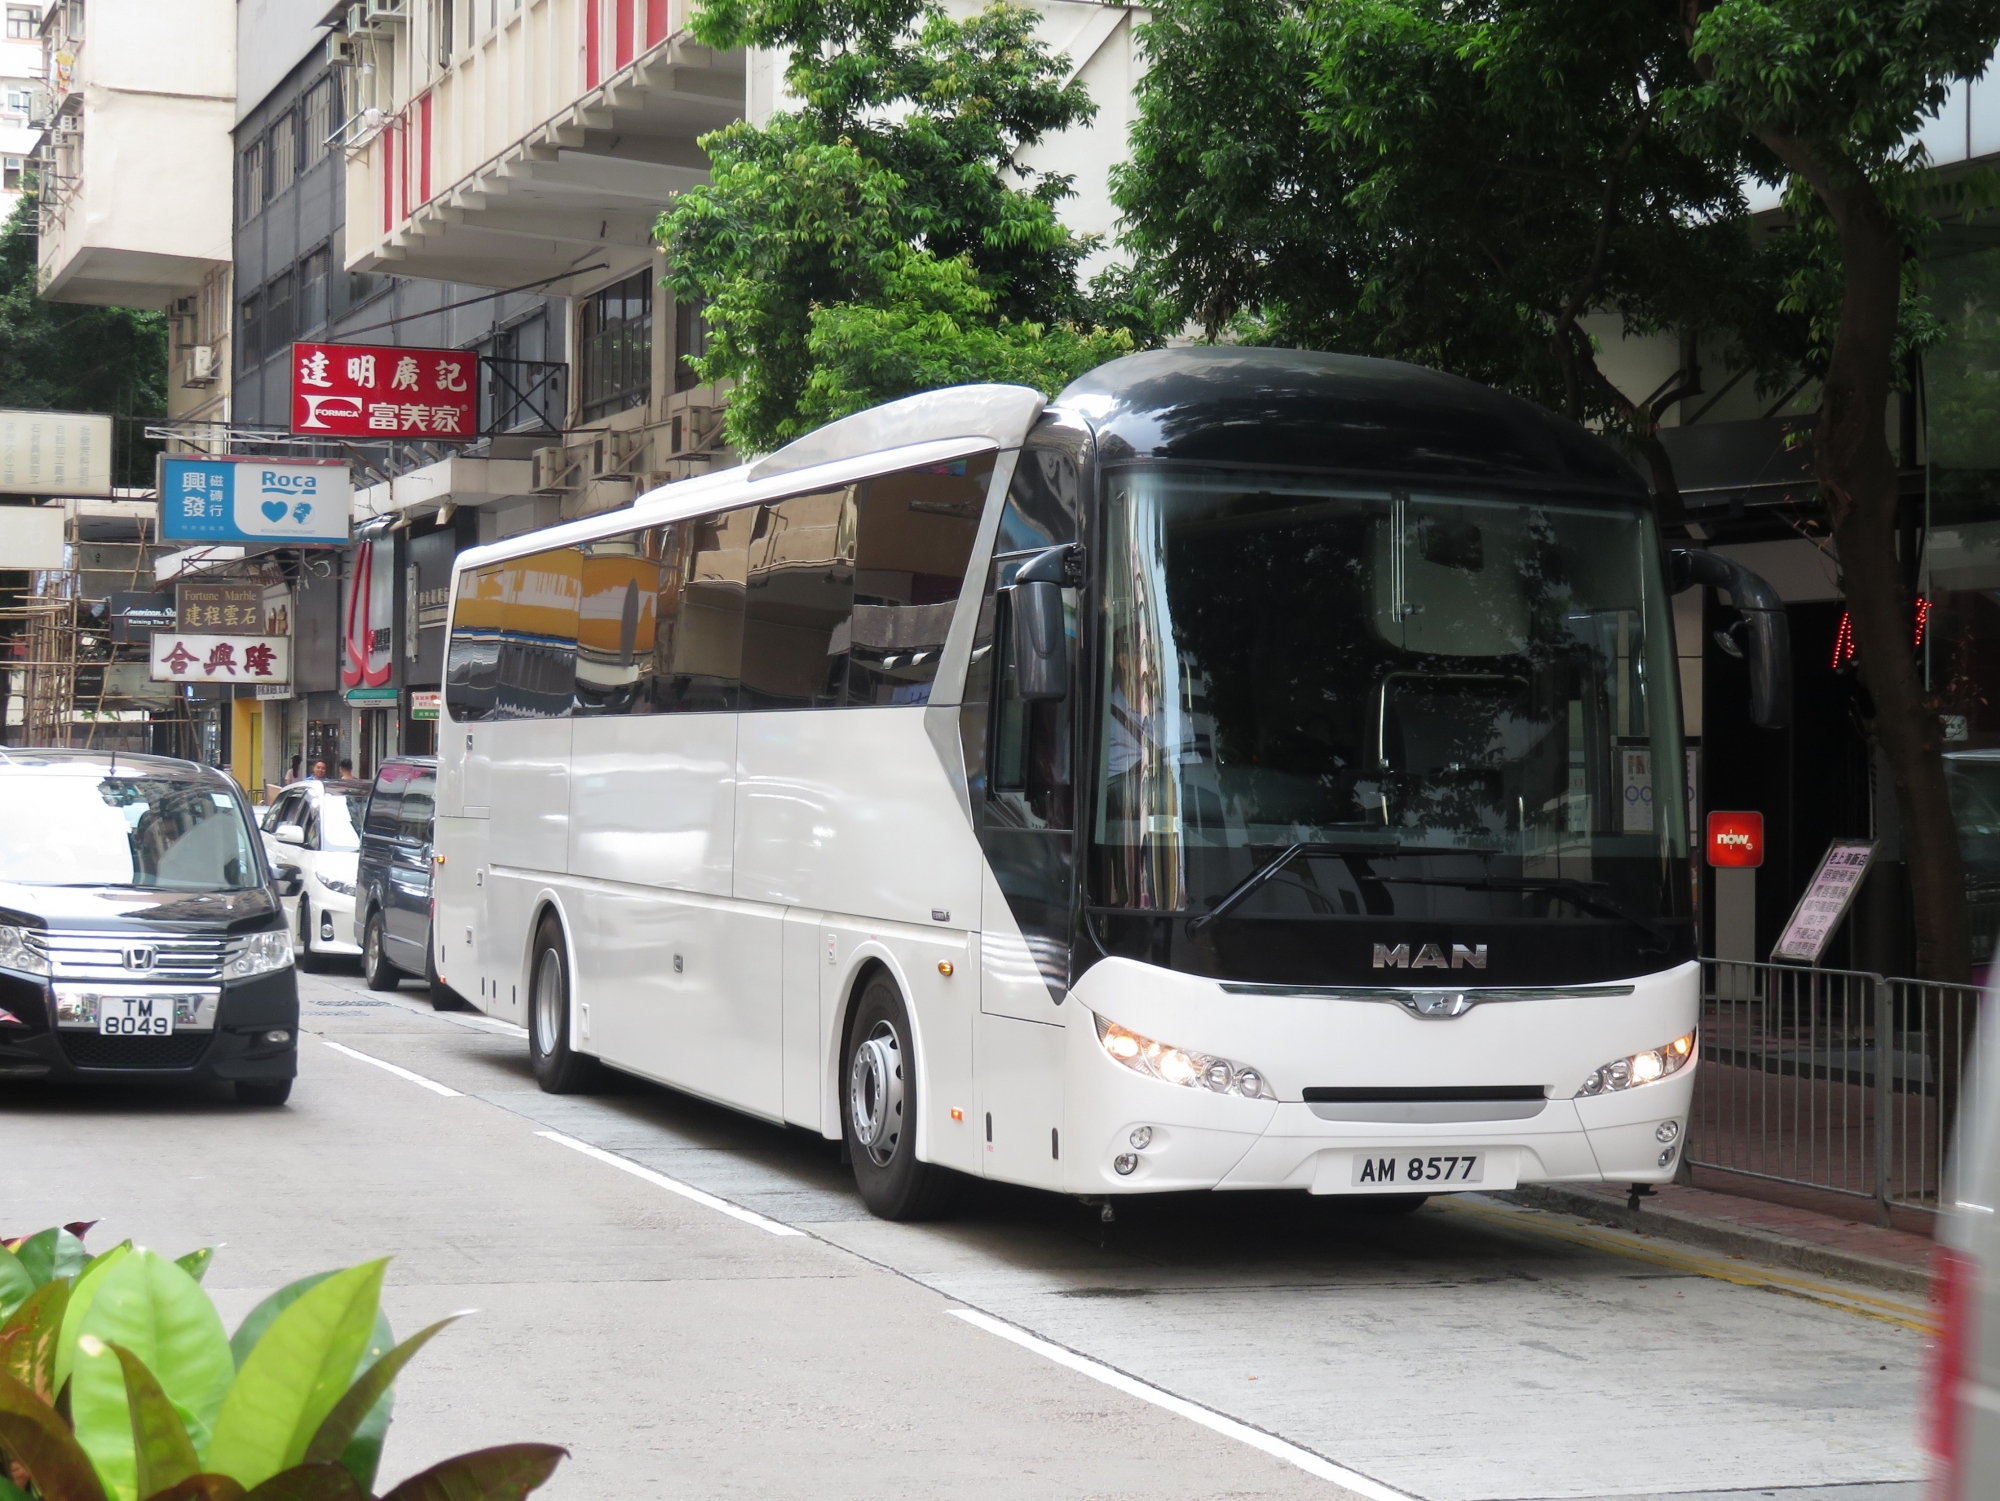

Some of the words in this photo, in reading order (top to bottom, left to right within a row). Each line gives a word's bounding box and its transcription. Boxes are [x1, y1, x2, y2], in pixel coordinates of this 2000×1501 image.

[300, 351, 467, 392] 達明廣記
[315, 408, 360, 418] FORMICA
[368, 402, 461, 433] 富美家
[261, 471, 317, 488] Roca
[182, 472, 207, 518] 興發
[209, 475, 224, 517] 磁磚行
[185, 590, 219, 601] Fortune
[225, 590, 257, 601] Marble
[185, 603, 257, 627] 建程雲石
[160, 641, 277, 676] 合興隆
[1716, 830, 1749, 848] now
[1829, 852, 1868, 866] 老上海飯店
[1372, 943, 1488, 969] MAN
[122, 1000, 153, 1017] TM
[105, 1017, 168, 1035] 8049
[1359, 1158, 1396, 1182] AM
[1407, 1156, 1477, 1181] 8577
